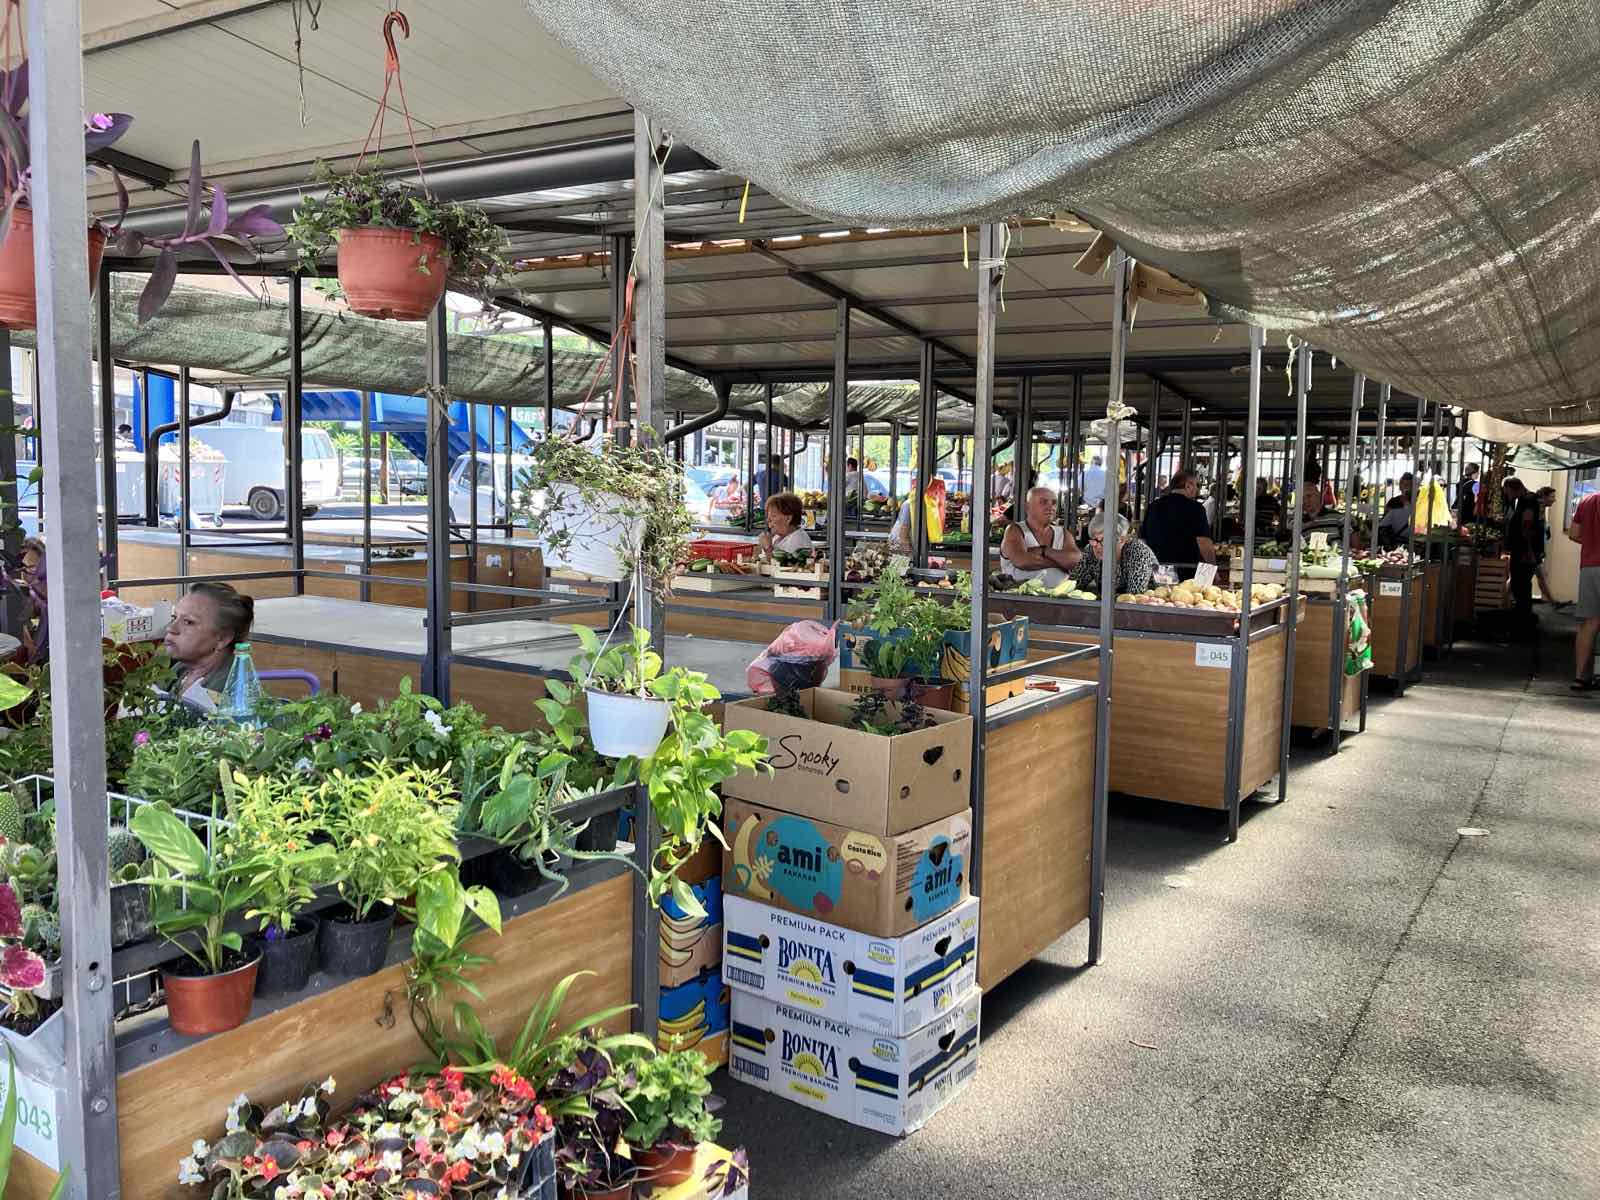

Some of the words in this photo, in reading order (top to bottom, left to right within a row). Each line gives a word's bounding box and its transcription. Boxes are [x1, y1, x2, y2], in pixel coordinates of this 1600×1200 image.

[1209, 651, 1228, 662] 045
[768, 734, 840, 776] Snooky
[777, 844, 822, 873] ami
[847, 844, 867, 854] Costa
[867, 849, 882, 857] Rica
[924, 858, 953, 893] ami
[770, 912, 816, 934] PREMIUM
[819, 926, 846, 943] PACK
[778, 936, 837, 984] BONITA
[777, 973, 805, 987] PREMIUM
[806, 982, 836, 996] BANANAS
[776, 1003, 821, 1029] PREMIUM
[824, 1019, 851, 1037] PACK
[781, 1029, 839, 1079] BONITA
[781, 1066, 809, 1081] PREMIUM
[808, 1077, 839, 1092] BANANAS
[17, 1096, 52, 1140] 043
